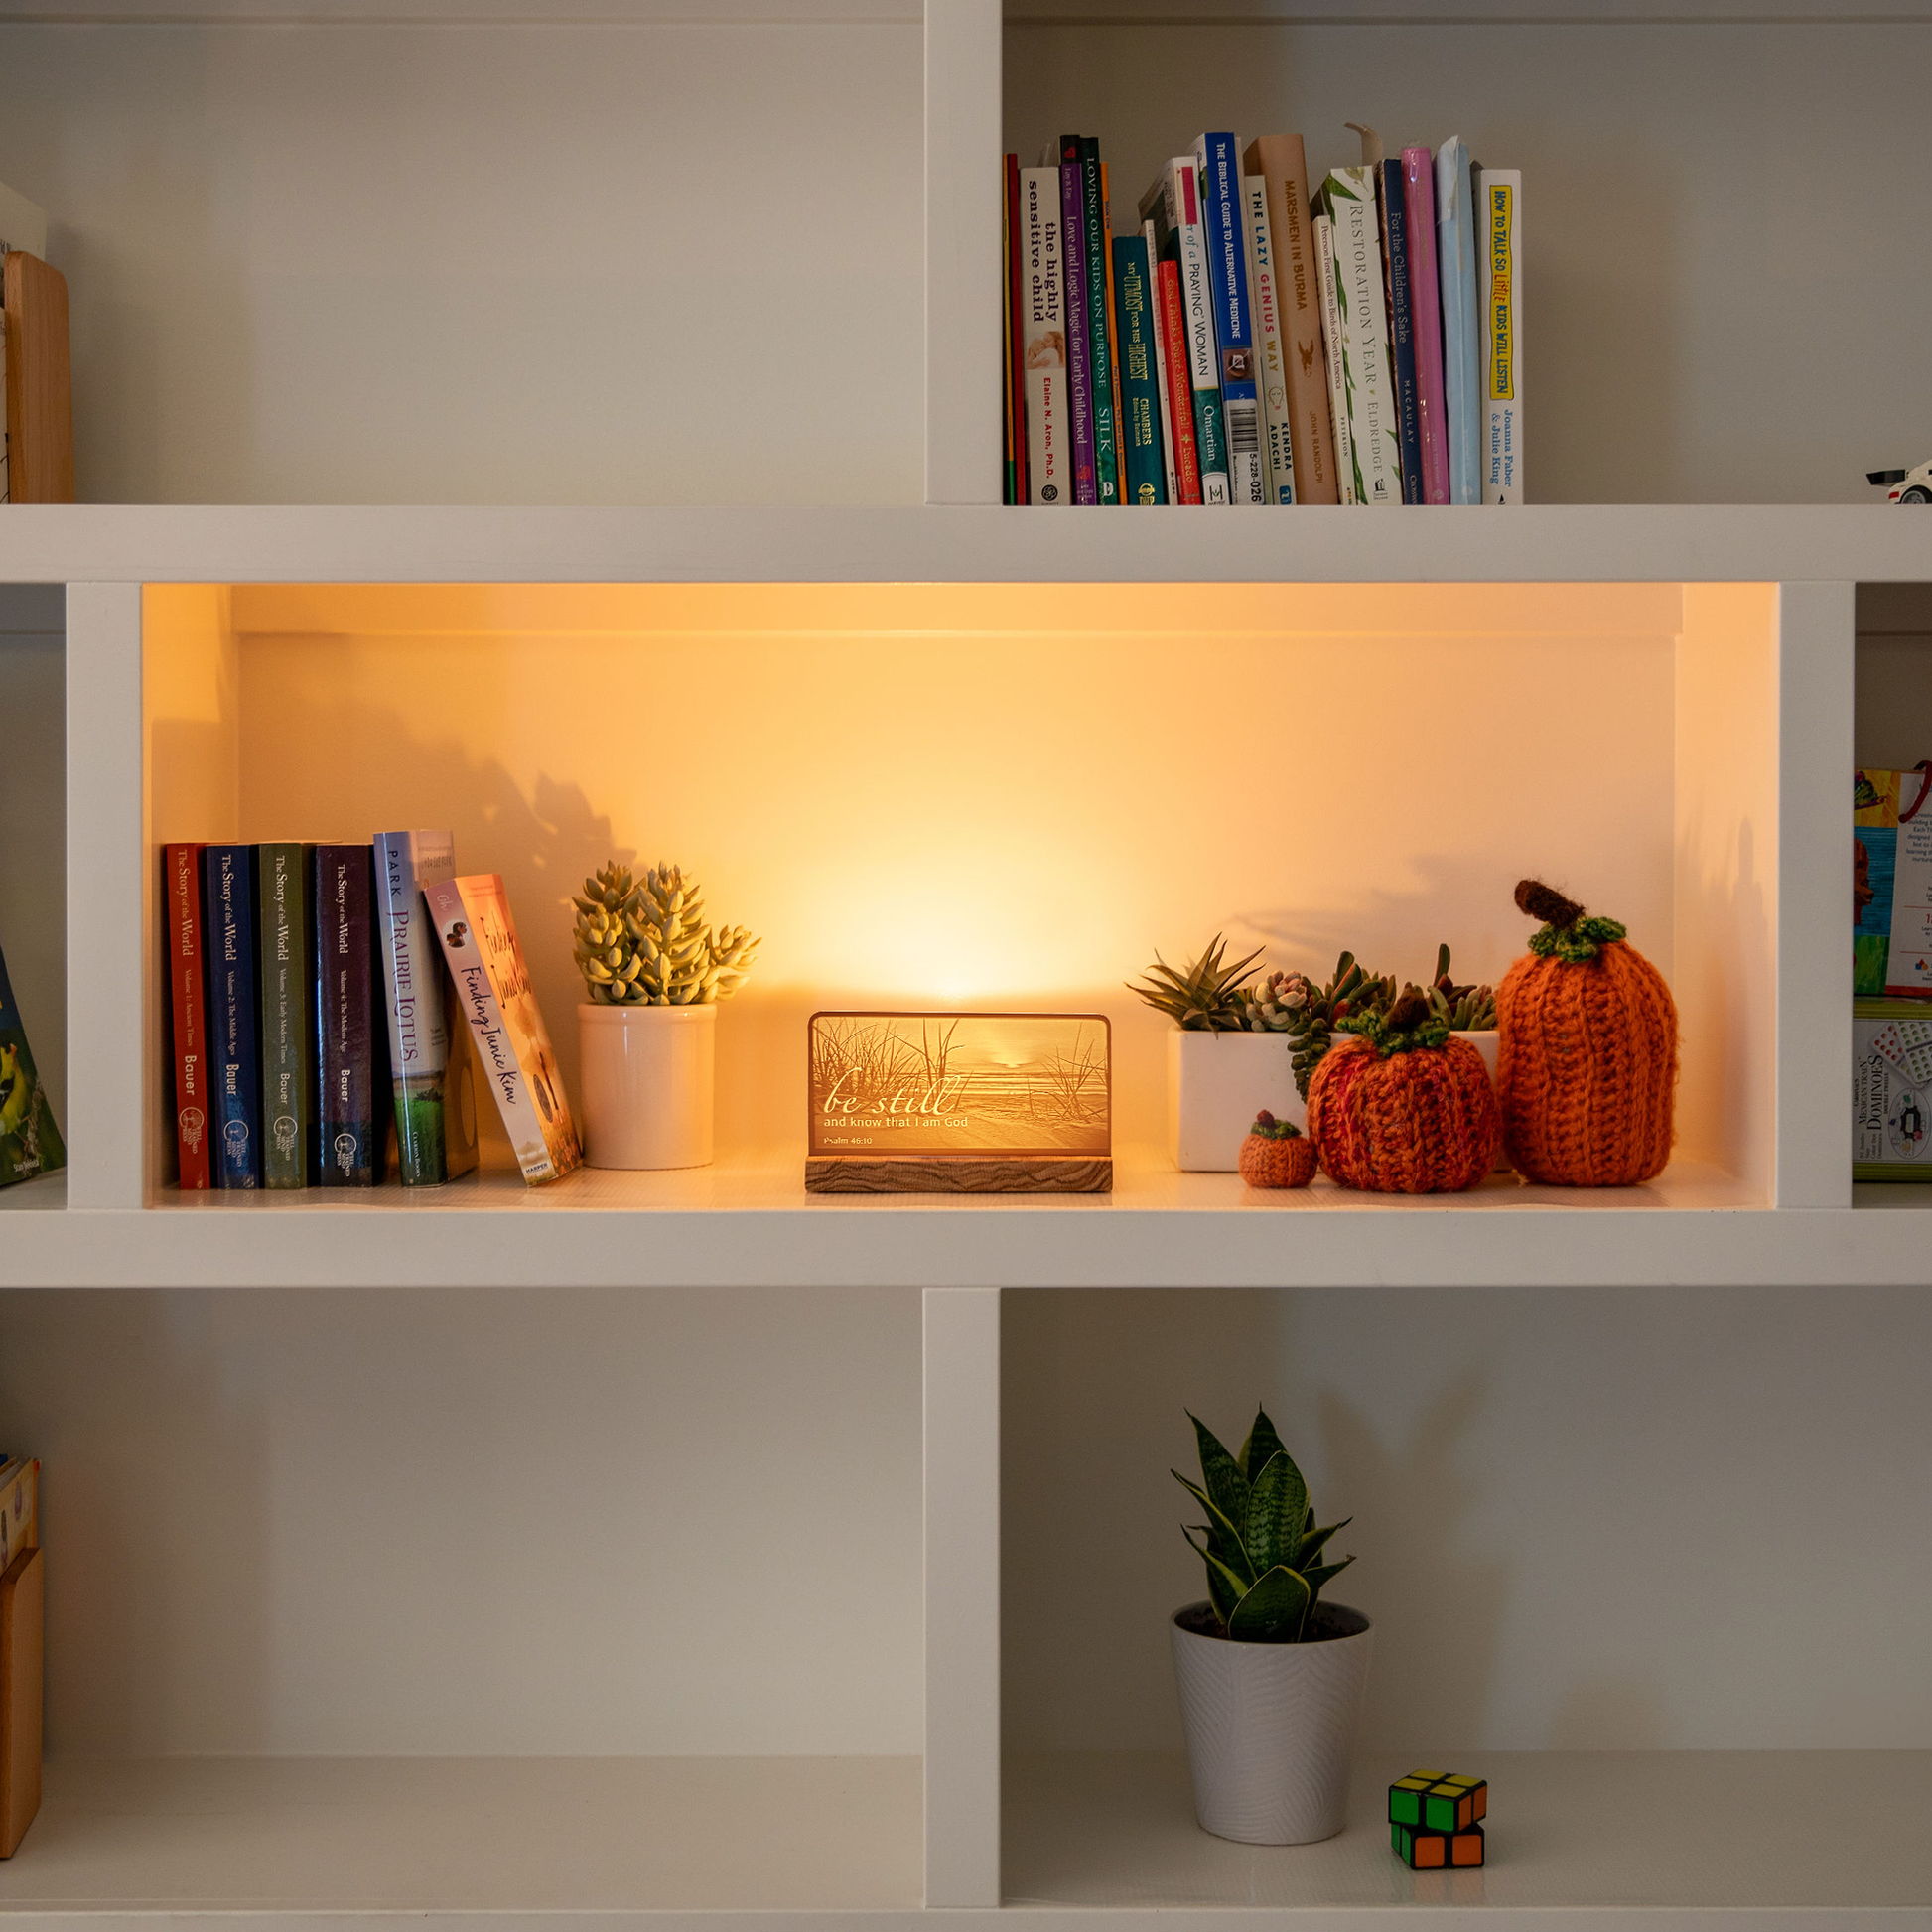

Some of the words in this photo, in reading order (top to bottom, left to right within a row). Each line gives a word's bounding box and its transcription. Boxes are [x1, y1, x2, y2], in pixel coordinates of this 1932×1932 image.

[1216, 142, 1226, 159] THE
[1087, 157, 1098, 214] LOVING
[1217, 161, 1229, 200] BIBLICAL
[1221, 202, 1231, 228] GUIDE
[1252, 191, 1263, 219] THE
[1284, 180, 1301, 242] MARSMEN
[1494, 191, 1506, 213] HOW
[1029, 181, 1041, 268] sensitive
[1066, 216, 1077, 246] Love
[1089, 219, 1099, 253] OUR
[1223, 229, 1232, 240] TO
[1391, 212, 1402, 230] For
[1495, 215, 1506, 228] TO
[1045, 222, 1056, 252] the
[1255, 226, 1268, 266] LAZY
[1321, 225, 1331, 255] Peterson
[1393, 234, 1403, 252] the
[1493, 230, 1506, 256] TALK
[1067, 247, 1079, 267] and
[1127, 262, 1135, 275] MY
[1291, 246, 1302, 260] IN
[1495, 258, 1506, 271] SO
[1068, 268, 1080, 299] Logic
[1091, 256, 1101, 291] KIDS
[1224, 242, 1237, 296] ALTERNATIVE
[1394, 255, 1407, 313] Children's
[1033, 275, 1043, 323] child
[1044, 259, 1059, 322] highly
[1124, 275, 1143, 312] UTMOST
[1167, 279, 1175, 299] God
[1293, 263, 1308, 310] BURMA
[1325, 275, 1334, 296] Guide
[1350, 206, 1372, 329] RESTORATION
[1362, 337, 1377, 384] YEAR
[1093, 295, 1103, 318] ON
[1185, 235, 1198, 248] of
[1194, 321, 1208, 375] WOMAN
[1260, 273, 1274, 333] GENIUS
[1327, 297, 1334, 306] to
[1328, 308, 1337, 323] Birds
[1069, 301, 1082, 334] Magic
[1169, 303, 1178, 337] Thinks
[1230, 298, 1240, 339] MEDICINE
[1330, 324, 1338, 334] of
[1398, 316, 1409, 343] Sake
[1496, 305, 1507, 330] KIDS
[1072, 337, 1082, 353] for
[1095, 323, 1106, 388] PURPOSE
[1266, 340, 1279, 372] WAY
[1331, 336, 1340, 358] North
[1496, 333, 1508, 356] WILL
[1071, 355, 1084, 384] Early
[1129, 343, 1148, 380] HIGHEST
[1496, 359, 1508, 393] LISTEN
[1043, 377, 1052, 406] Elaine
[1044, 410, 1052, 420] N.
[1074, 386, 1087, 444] Childhood
[1140, 398, 1152, 445] CHAMBERS
[1404, 379, 1414, 443] MACAULAY
[1491, 413, 1500, 422] &
[1044, 424, 1053, 450] Aron,
[1099, 407, 1111, 452] SILK
[1203, 405, 1216, 461] Omartian
[1368, 402, 1382, 473] ELDREDGE
[1491, 425, 1501, 454] Julie
[1504, 409, 1513, 452] Joanna
[1270, 424, 1281, 470] ADACHI
[1281, 422, 1292, 470] KENDRA
[1312, 438, 1323, 483] RANDOLPH
[1045, 454, 1054, 479] Ph.D.
[1183, 447, 1194, 483] Lucado
[1490, 457, 1501, 484] King
[1504, 455, 1514, 487] Faber
[178, 849, 187, 867] The
[222, 854, 231, 872] The
[276, 855, 285, 872] The
[337, 864, 345, 879] The
[177, 867, 191, 897] Story
[220, 872, 234, 902] Story
[273, 874, 288, 902] Story
[388, 851, 401, 897] PARK
[225, 903, 233, 912] of
[336, 879, 347, 905] Story
[437, 894, 453, 911] Oh
[278, 904, 286, 913] of
[182, 918, 194, 956] World
[225, 924, 237, 961] World
[277, 924, 289, 961] World
[339, 923, 348, 954] World
[387, 910, 412, 994] PRAIRIE
[278, 1001, 287, 1018] Early
[394, 996, 418, 1061] LOTUS
[461, 966, 491, 1028] Finding
[481, 1027, 505, 1069] Junie
[496, 1071, 517, 1104] Kim
[339, 1040, 347, 1052] Age
[185, 1055, 198, 1095] Bauer
[226, 1064, 239, 1095] Bauer
[280, 1073, 290, 1105] Bauer
[341, 1069, 350, 1102] Bauer
[824, 1067, 862, 1113] be
[872, 1075, 961, 1115] still
[1858, 1087, 1867, 1124] MEXICAN
[1866, 1055, 1884, 1130] DOMINOES
[824, 1117, 846, 1127] and
[851, 1117, 882, 1127] know
[886, 1118, 910, 1127] that
[915, 1118, 919, 1127] I
[944, 1117, 968, 1127] God
[526, 1163, 548, 1174] HARPER
